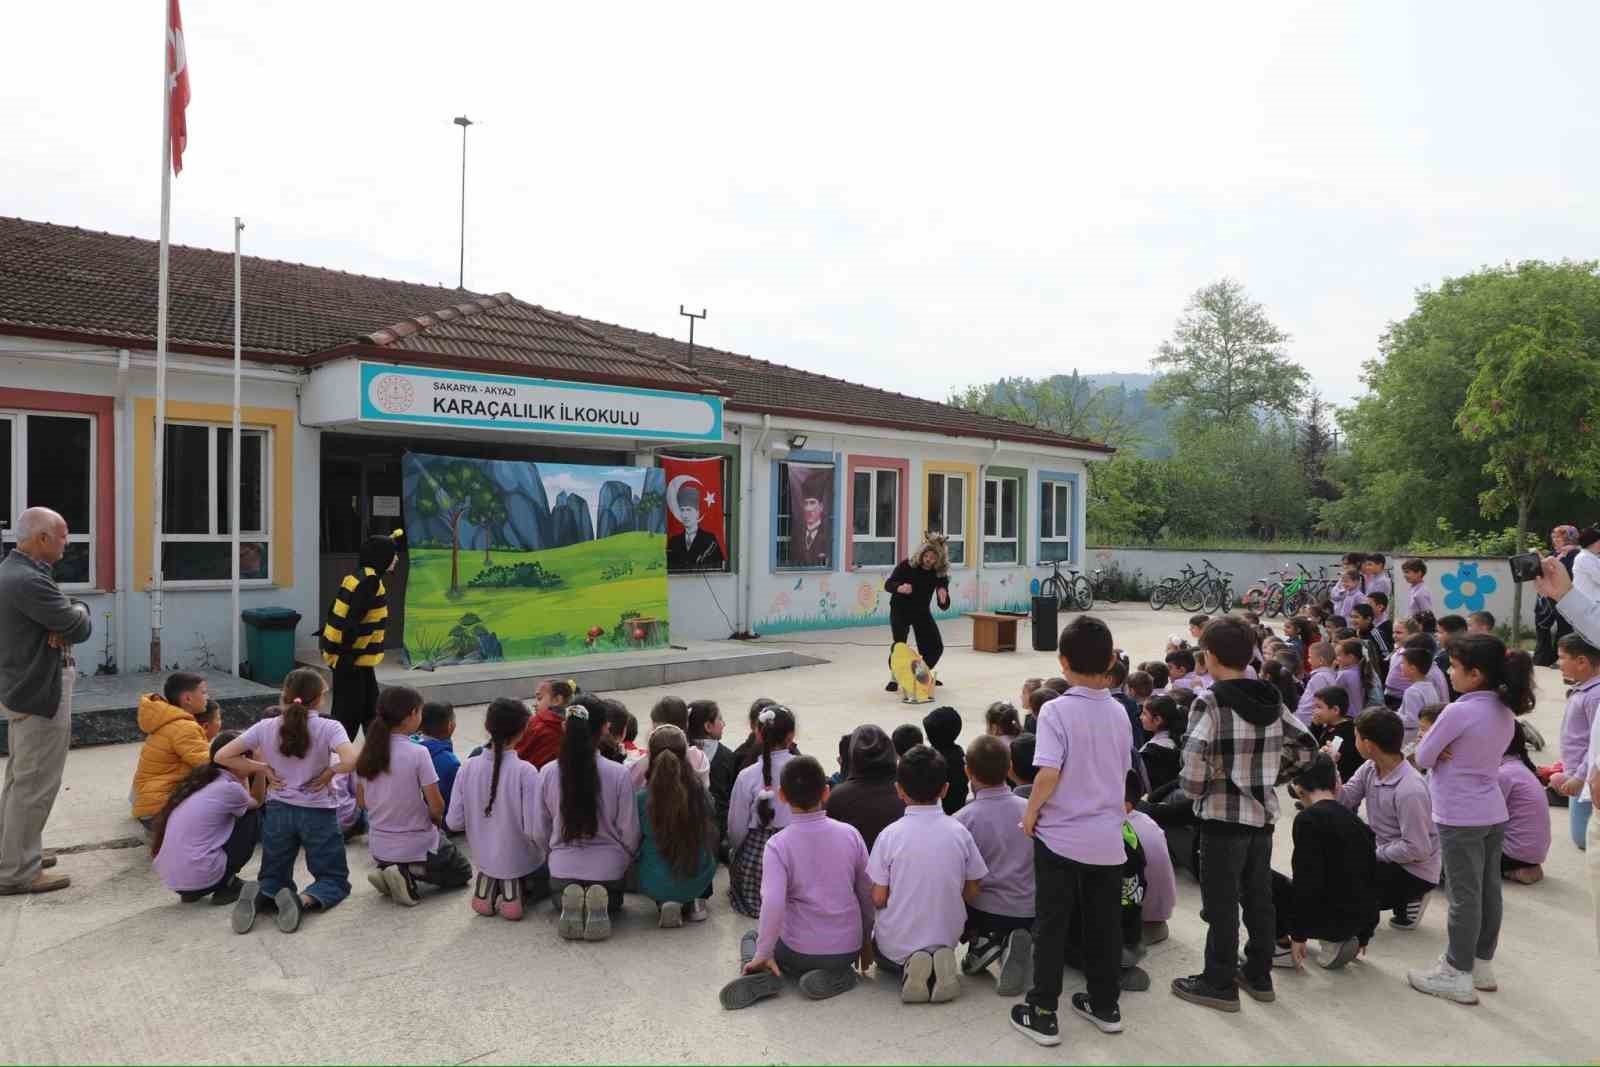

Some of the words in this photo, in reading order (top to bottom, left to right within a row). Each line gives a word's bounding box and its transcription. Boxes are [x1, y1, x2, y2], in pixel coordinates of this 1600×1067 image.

[433, 382, 478, 393] SAKARYA
[484, 386, 516, 396] AKYAZI
[433, 397, 555, 420] KARAÇALILIK
[560, 402, 639, 426] İLKOKULU
